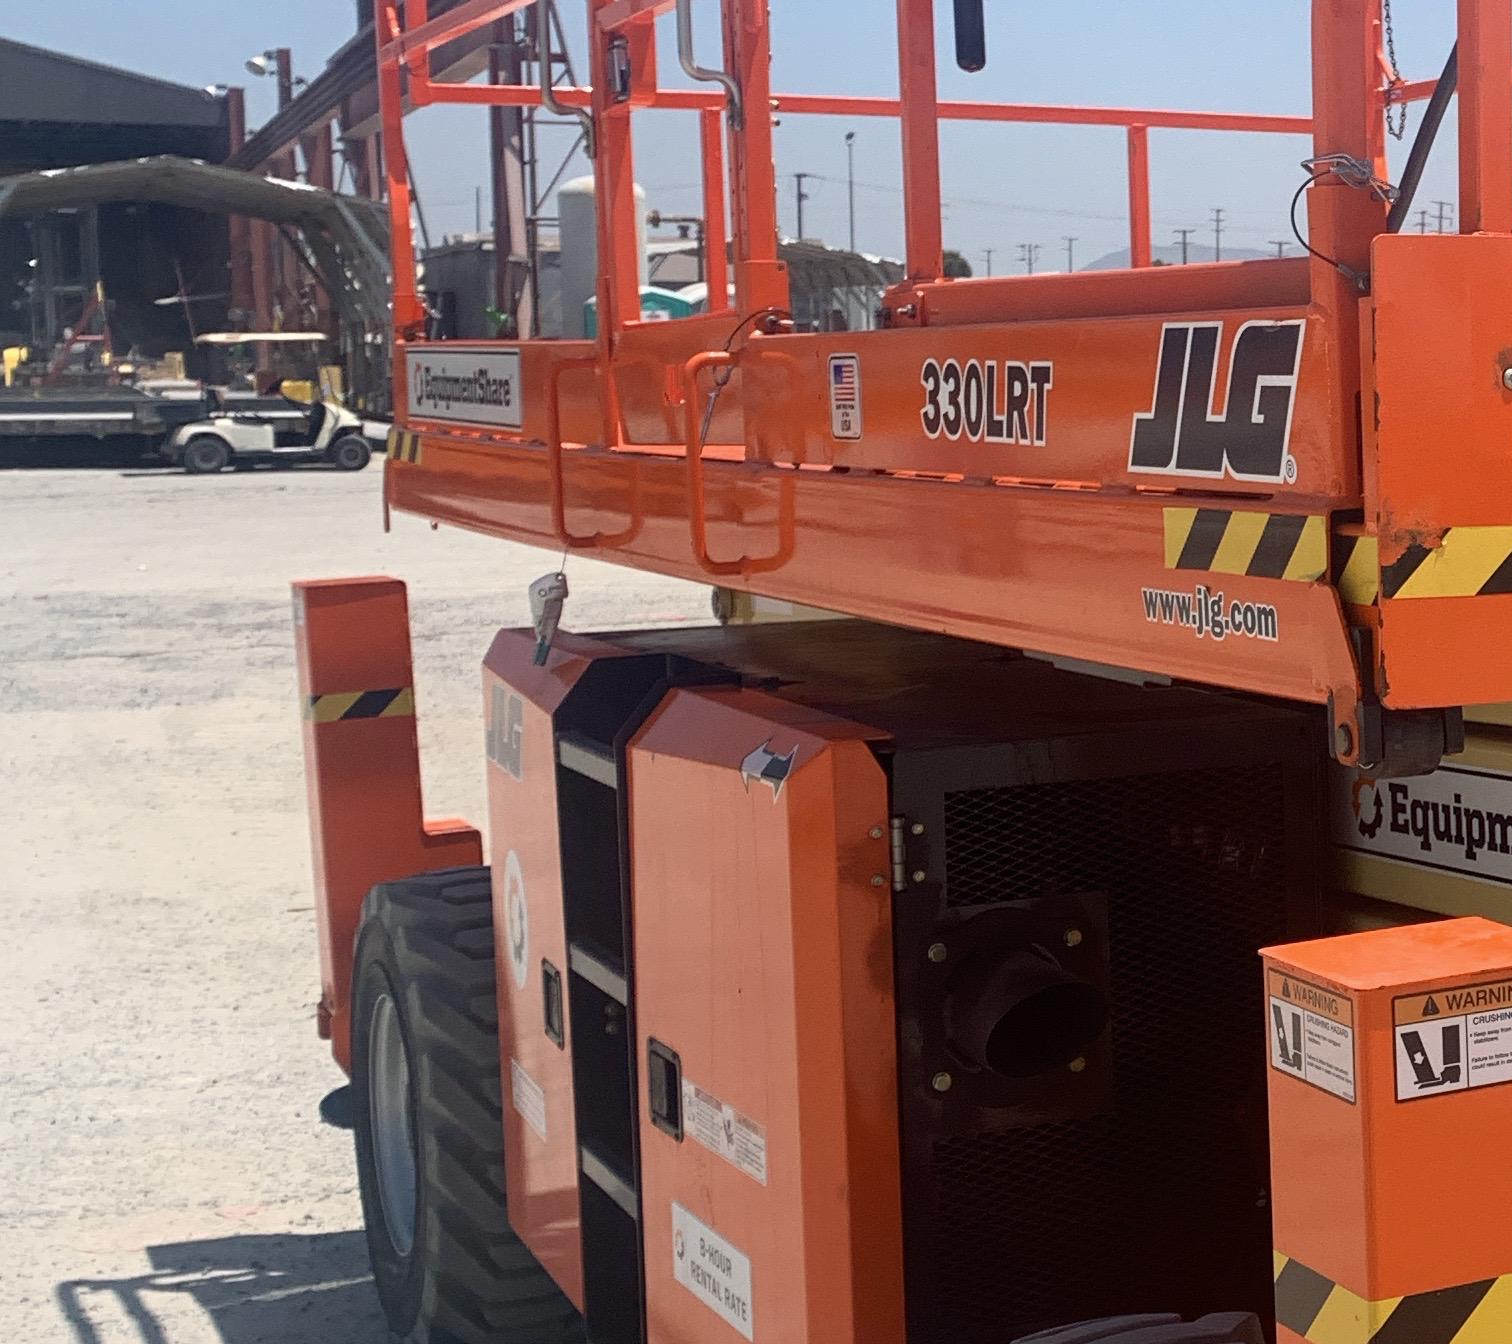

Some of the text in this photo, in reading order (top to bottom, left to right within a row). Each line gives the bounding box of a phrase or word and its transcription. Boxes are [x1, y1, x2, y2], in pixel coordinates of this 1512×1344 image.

[921, 358, 1053, 446] 330LRT
[1141, 586, 1278, 642] www.jlg.com
[1292, 982, 1338, 1016] WARNING
[690, 1259, 747, 1322] RENTAL RATE
